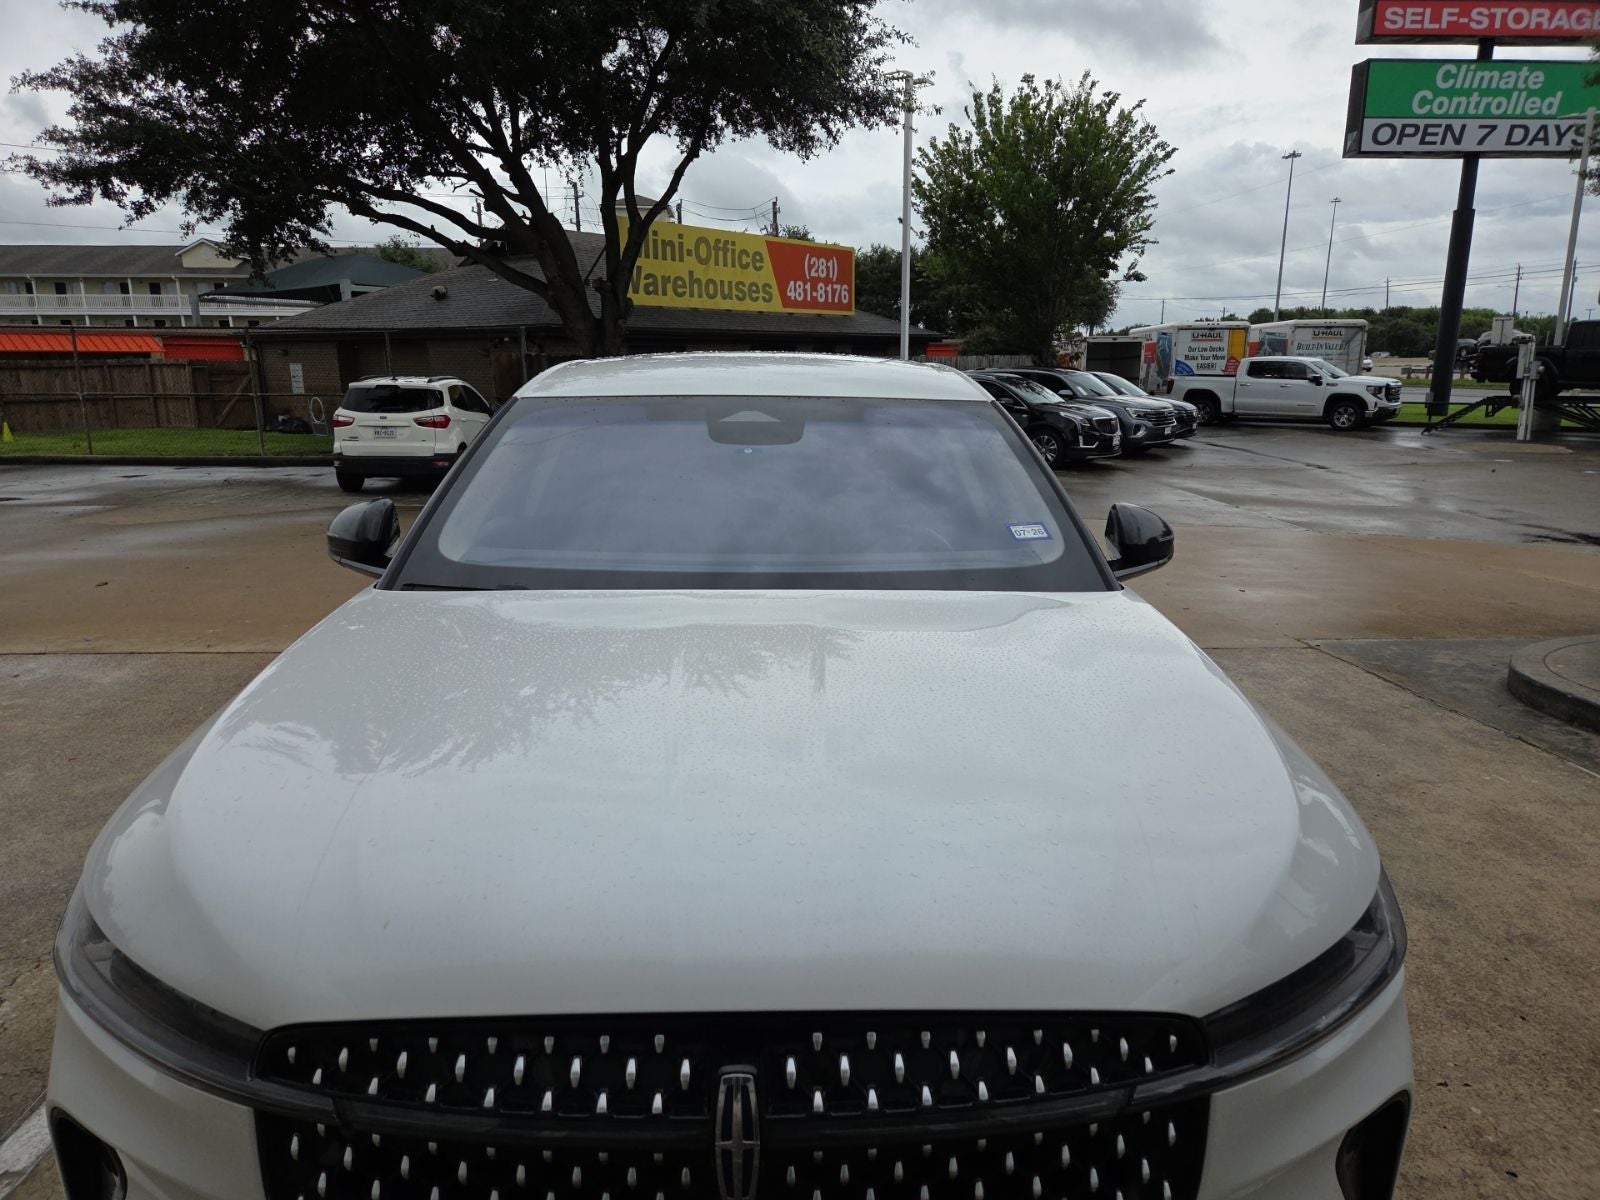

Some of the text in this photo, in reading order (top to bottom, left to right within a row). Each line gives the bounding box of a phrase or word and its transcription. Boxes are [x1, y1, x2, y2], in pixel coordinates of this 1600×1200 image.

[1436, 64, 1545, 90] Climate
[1412, 90, 1562, 115] Controlled
[1371, 122, 1466, 146] OPEN
[1476, 124, 1498, 146] 7
[804, 253, 838, 282] (281)
[786, 280, 849, 304] 481-8176
